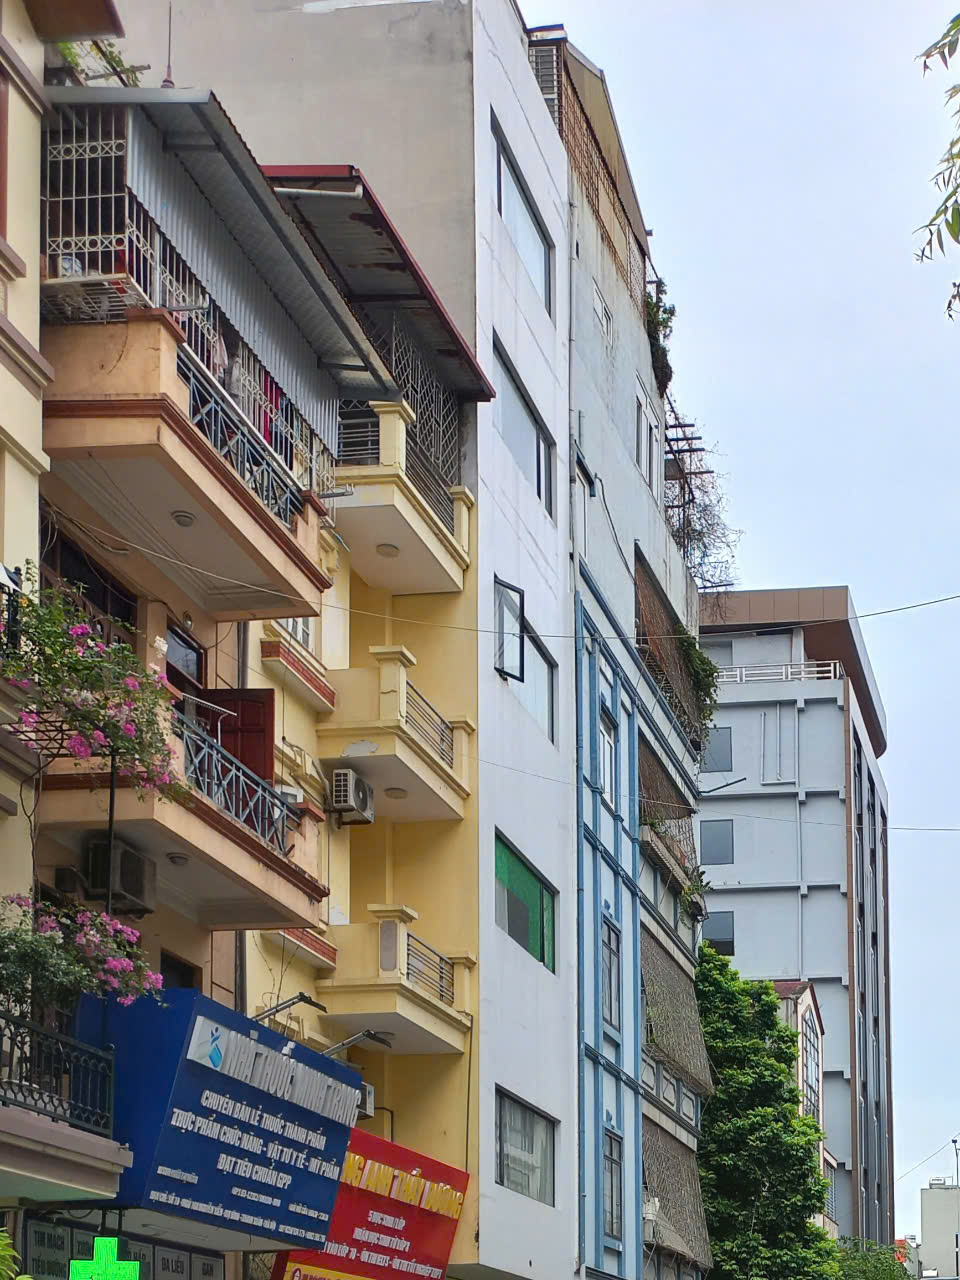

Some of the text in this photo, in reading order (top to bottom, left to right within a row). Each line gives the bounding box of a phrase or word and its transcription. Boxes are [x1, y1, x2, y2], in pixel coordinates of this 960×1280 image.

[251, 1041, 297, 1100] THUỐC
[170, 1107, 196, 1133] THỰC
[194, 1114, 221, 1139] PHẨM
[219, 1124, 242, 1146] CHỨC
[240, 1131, 264, 1155] NĂNG
[320, 1158, 340, 1181] PHẨM
[201, 1089, 327, 1151] CHUYÊN BÁN LẺ THUỐC THÀNH PHẨM
[217, 1153, 238, 1175] ĐẠT
[234, 1158, 251, 1178] TIÊU
[251, 1159, 278, 1185] CHUẨN
[276, 1173, 293, 1190] GPP
